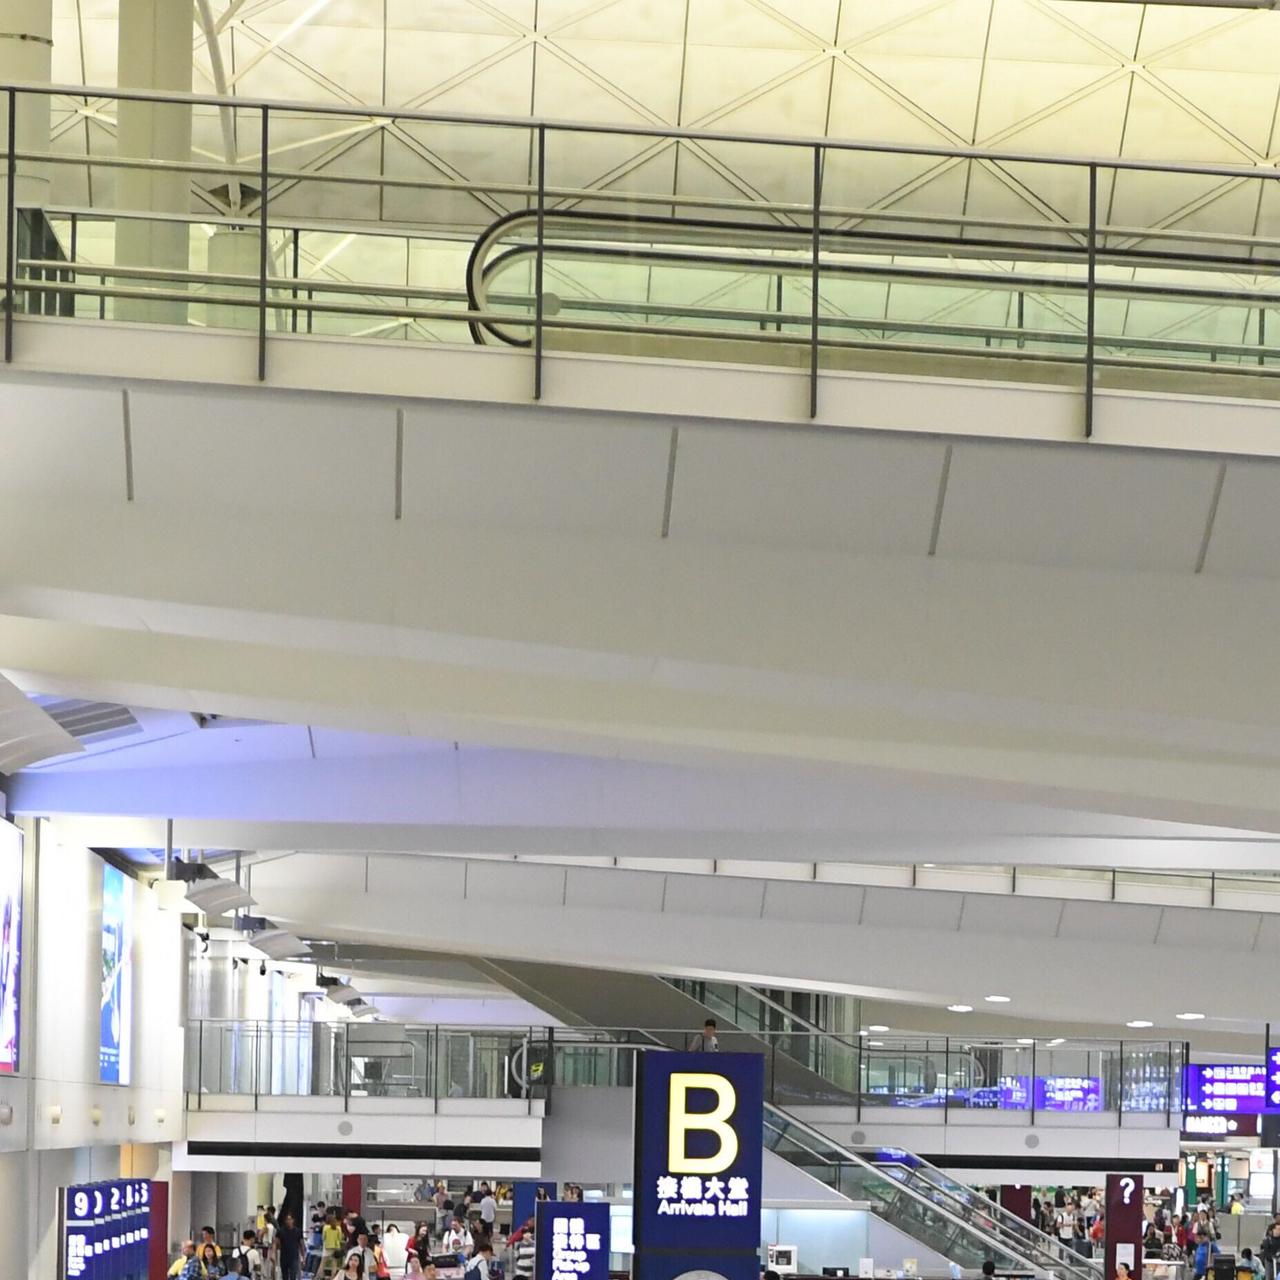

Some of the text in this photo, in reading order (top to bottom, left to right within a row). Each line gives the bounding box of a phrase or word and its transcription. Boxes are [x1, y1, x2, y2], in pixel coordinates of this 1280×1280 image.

[668, 1072, 739, 1175] B
[657, 1175, 749, 1200] 接機大堂
[657, 1199, 748, 1216] Arrivals Hall
